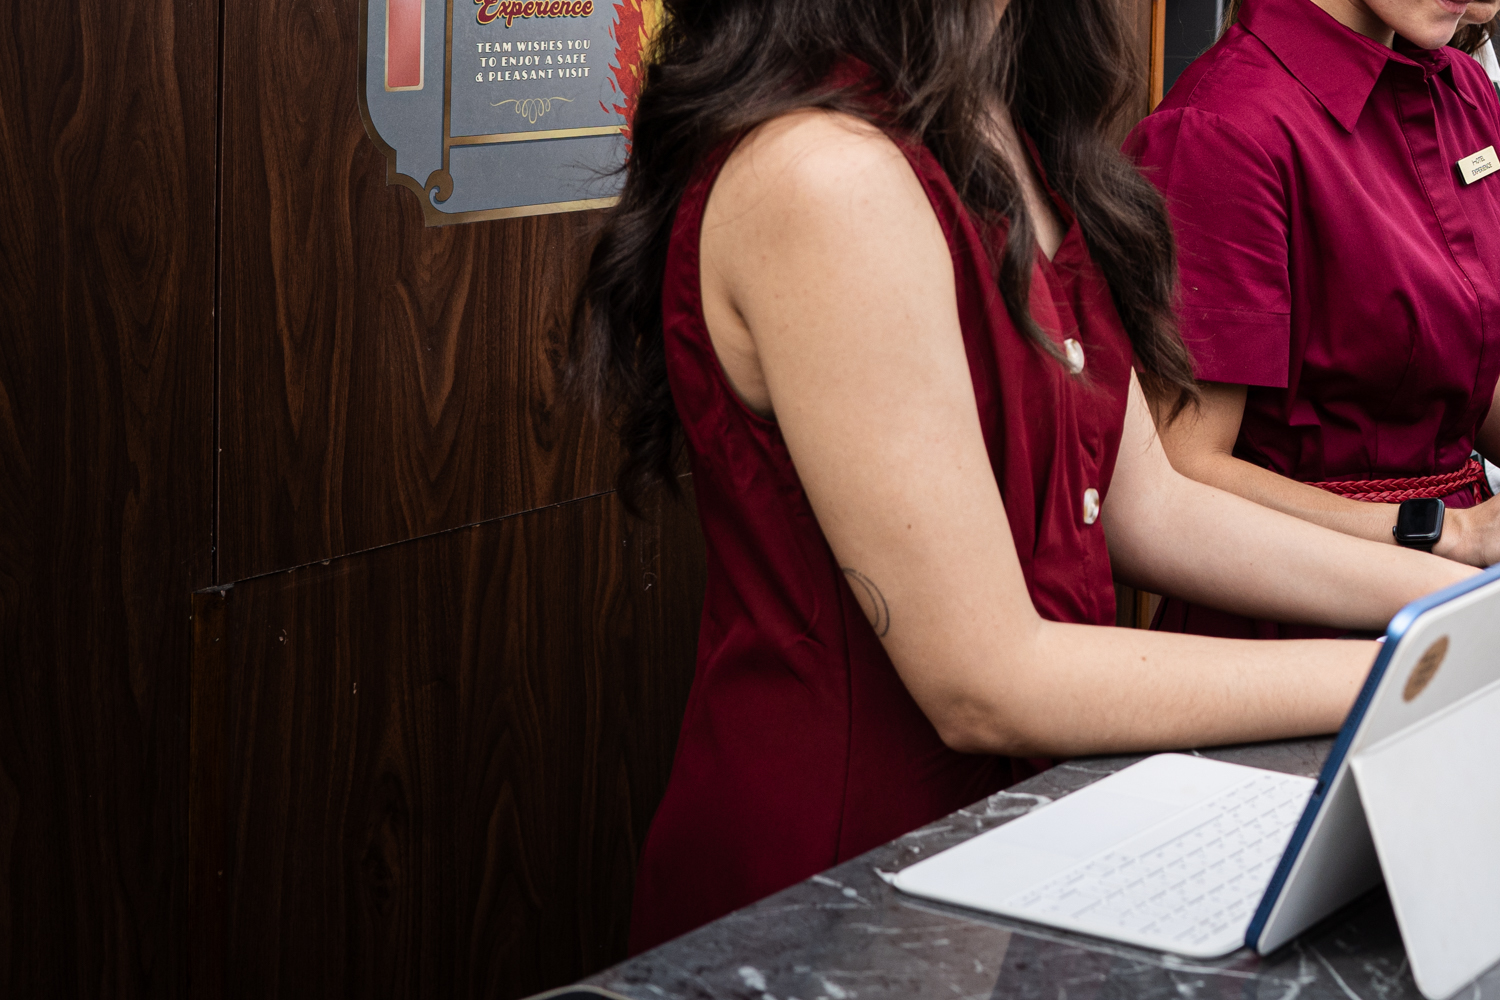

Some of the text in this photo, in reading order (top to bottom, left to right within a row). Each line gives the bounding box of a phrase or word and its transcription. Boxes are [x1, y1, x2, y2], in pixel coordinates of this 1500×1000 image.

[476, 39, 591, 53] TEAM WISHES YOU
[480, 53, 587, 68] TO ENJOY A SAFE
[475, 67, 591, 83] & PLEASANT VISIT
